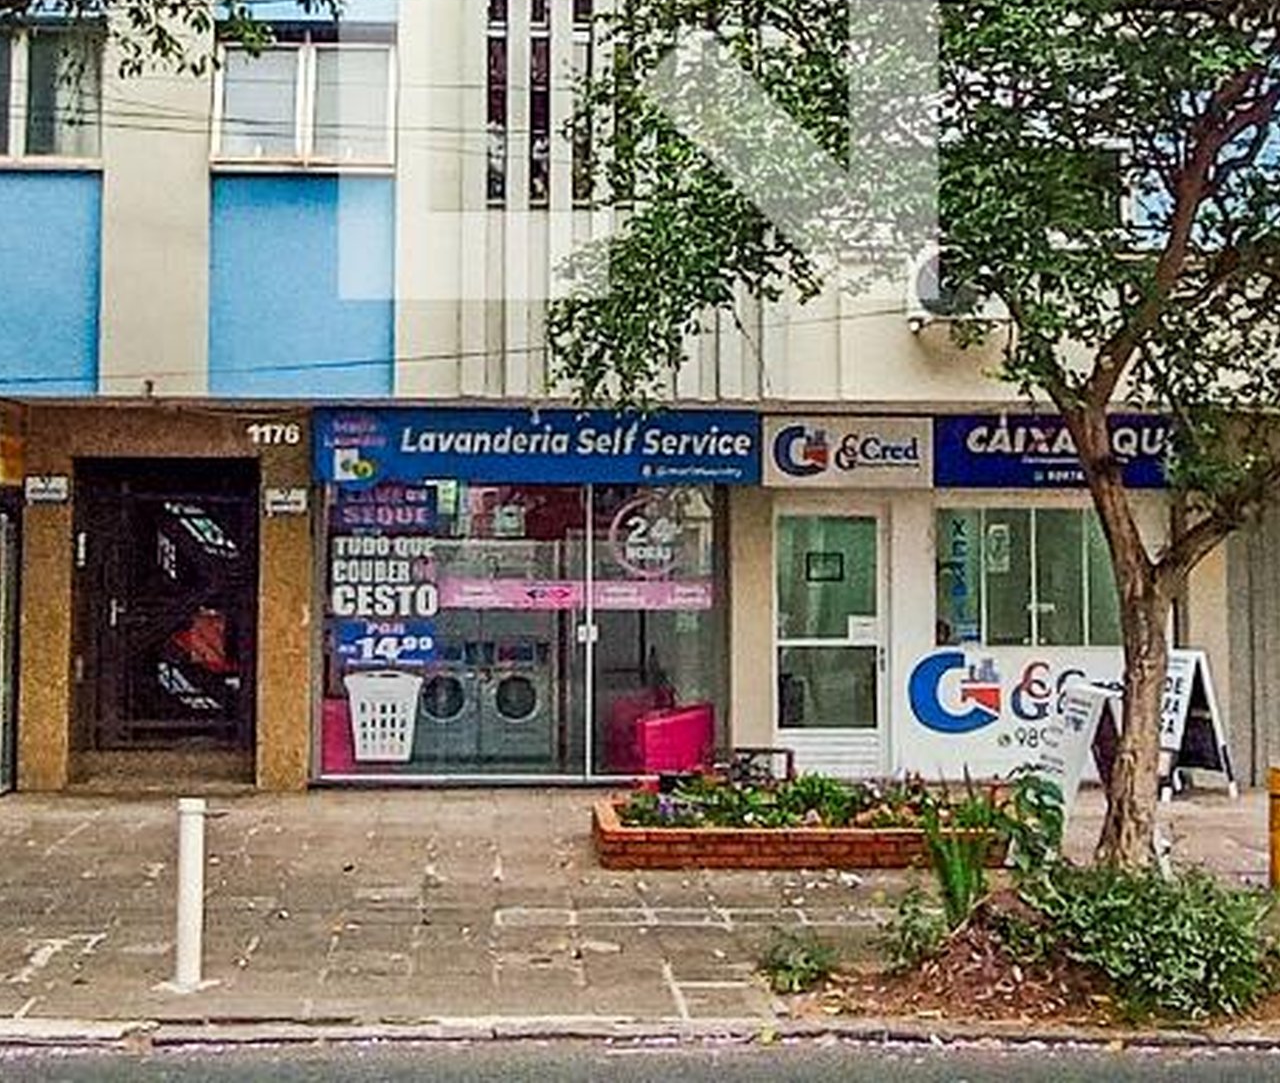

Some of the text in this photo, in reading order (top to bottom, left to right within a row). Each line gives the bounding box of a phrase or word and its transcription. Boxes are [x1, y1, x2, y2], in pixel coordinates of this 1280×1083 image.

[247, 423, 301, 445] 1176
[400, 422, 752, 456] Lavanderia Self Service
[966, 426, 1080, 454] CAIXA
[333, 536, 390, 556] TUDO
[332, 559, 410, 583] COUBER
[331, 584, 439, 617] CESTO
